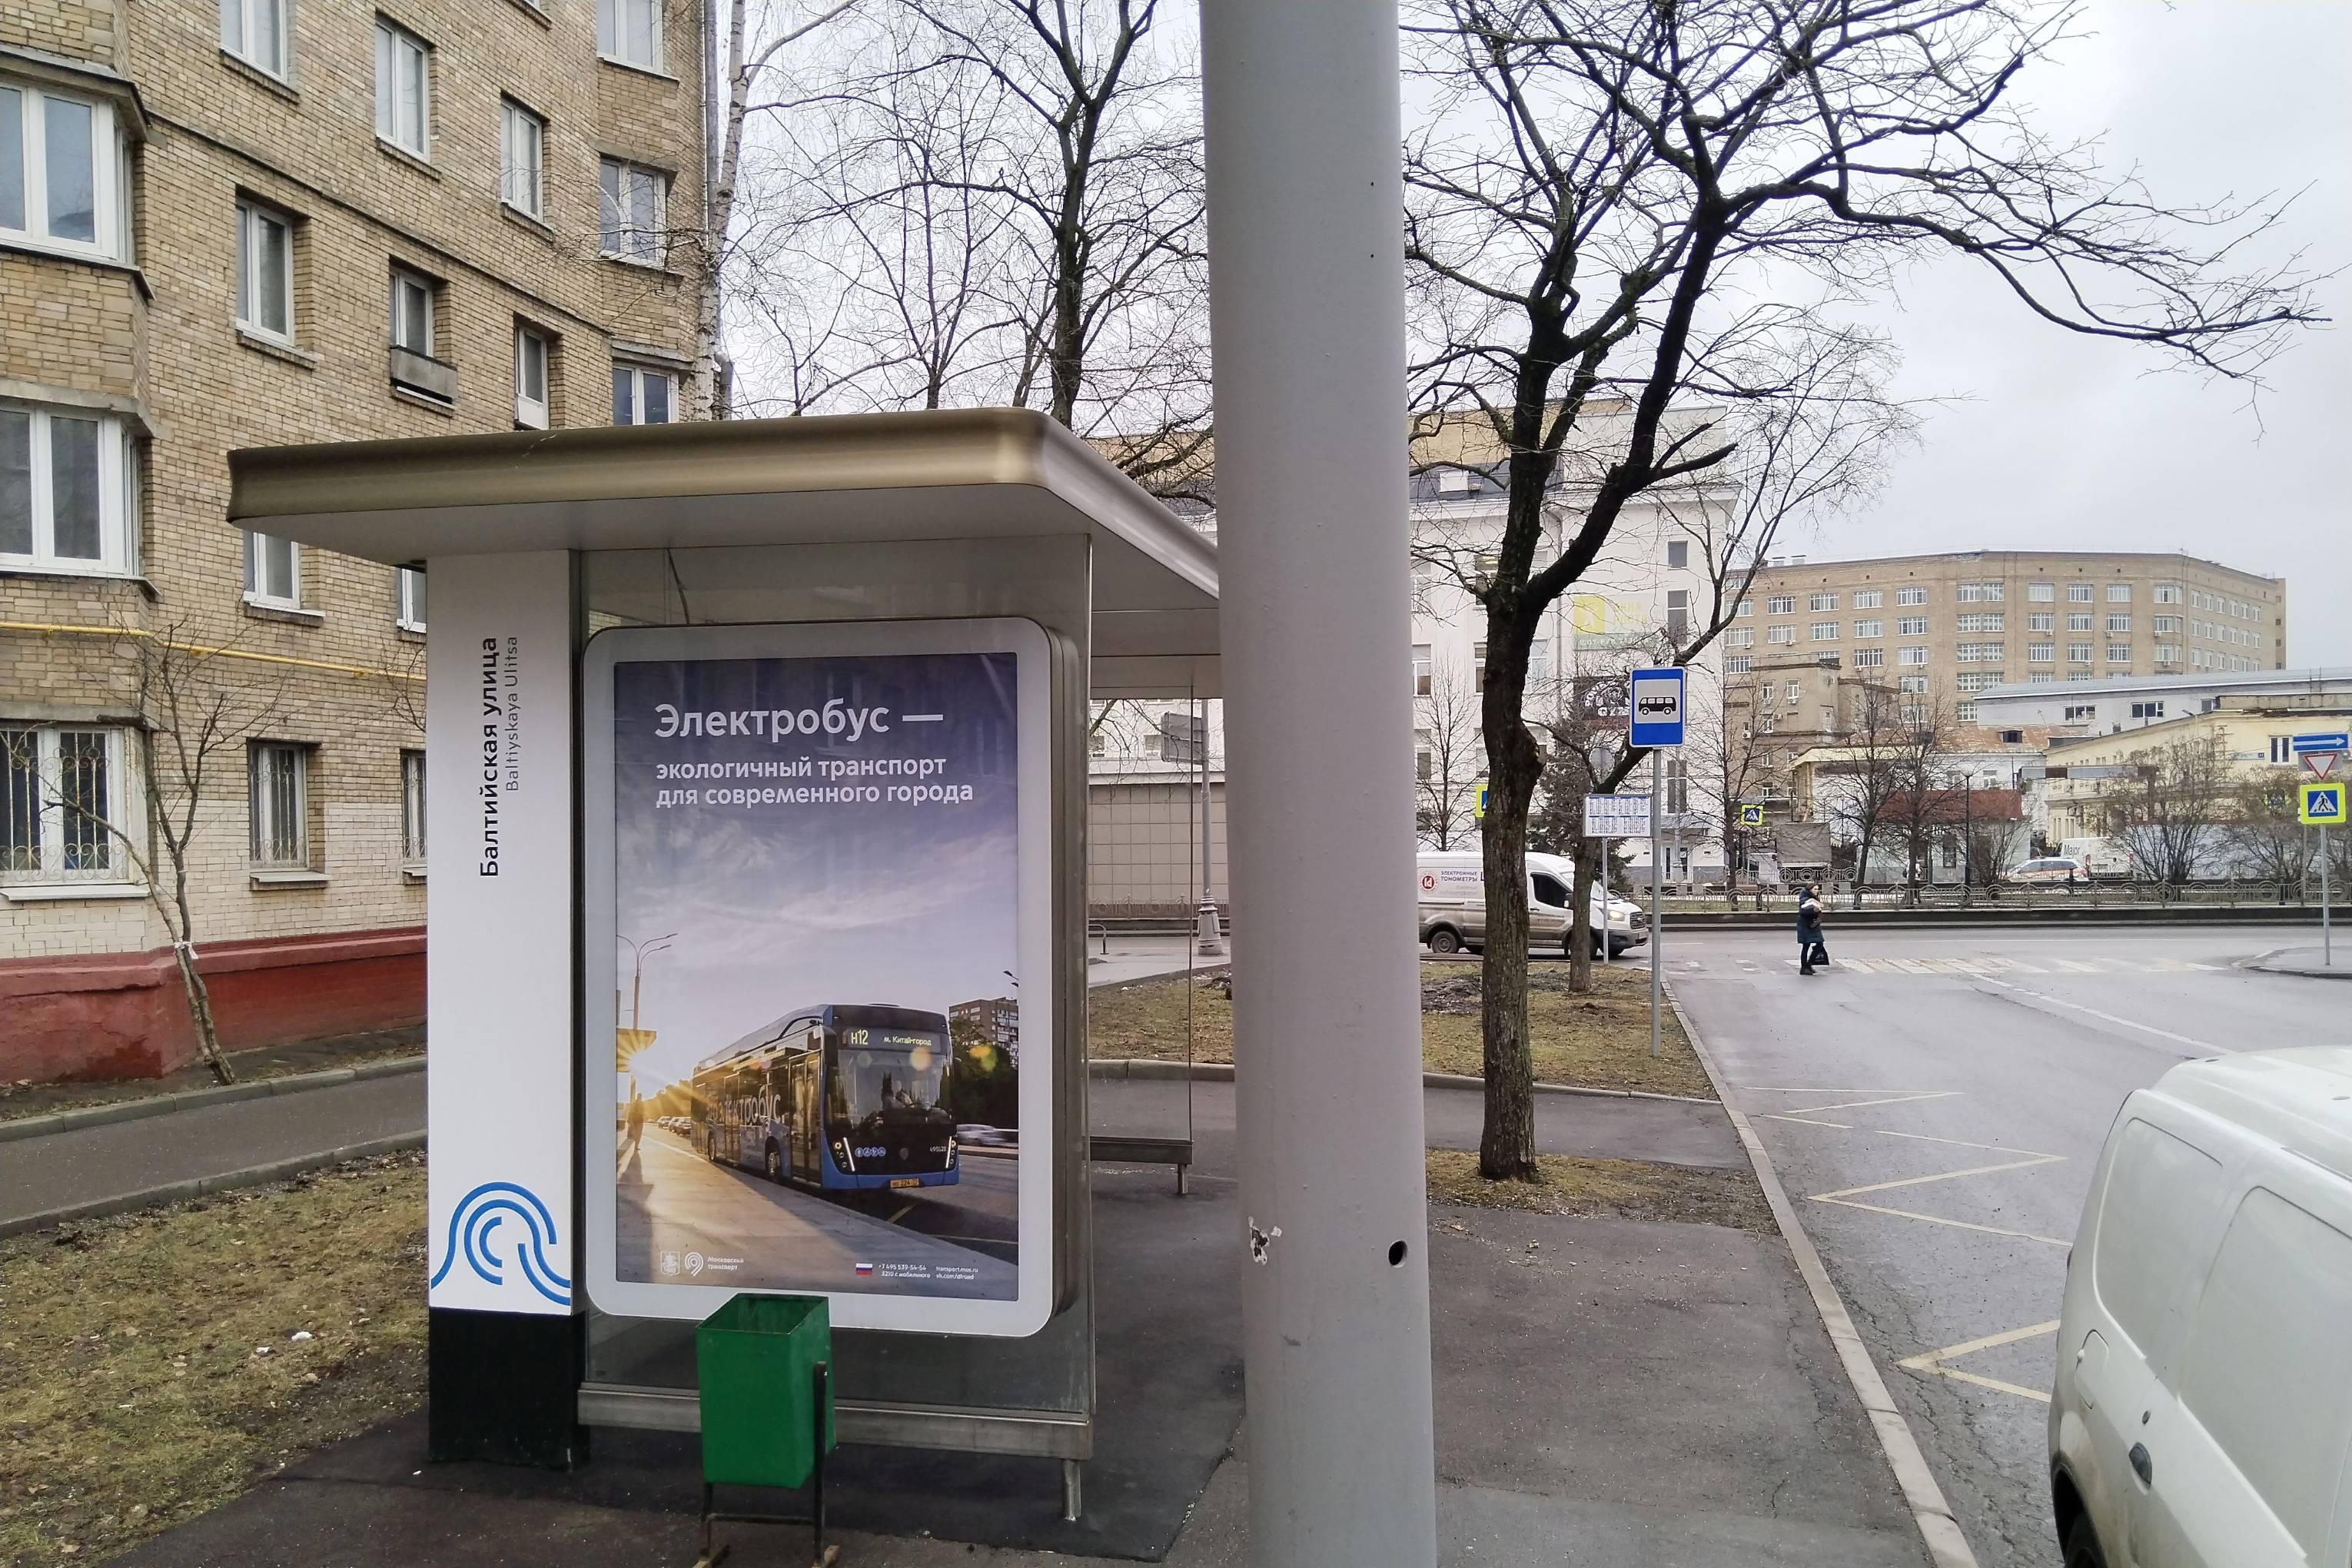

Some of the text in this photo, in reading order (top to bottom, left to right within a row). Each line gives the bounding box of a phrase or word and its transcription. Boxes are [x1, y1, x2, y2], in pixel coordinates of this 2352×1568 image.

[504, 636, 522, 792] Baltiyskaya Ulitsa
[654, 697, 890, 742] Электробус
[479, 637, 502, 876] Балтийская улица
[656, 756, 947, 781] экологичный транспорт
[656, 781, 974, 809] для современного города
[2064, 844, 2081, 858] Major
